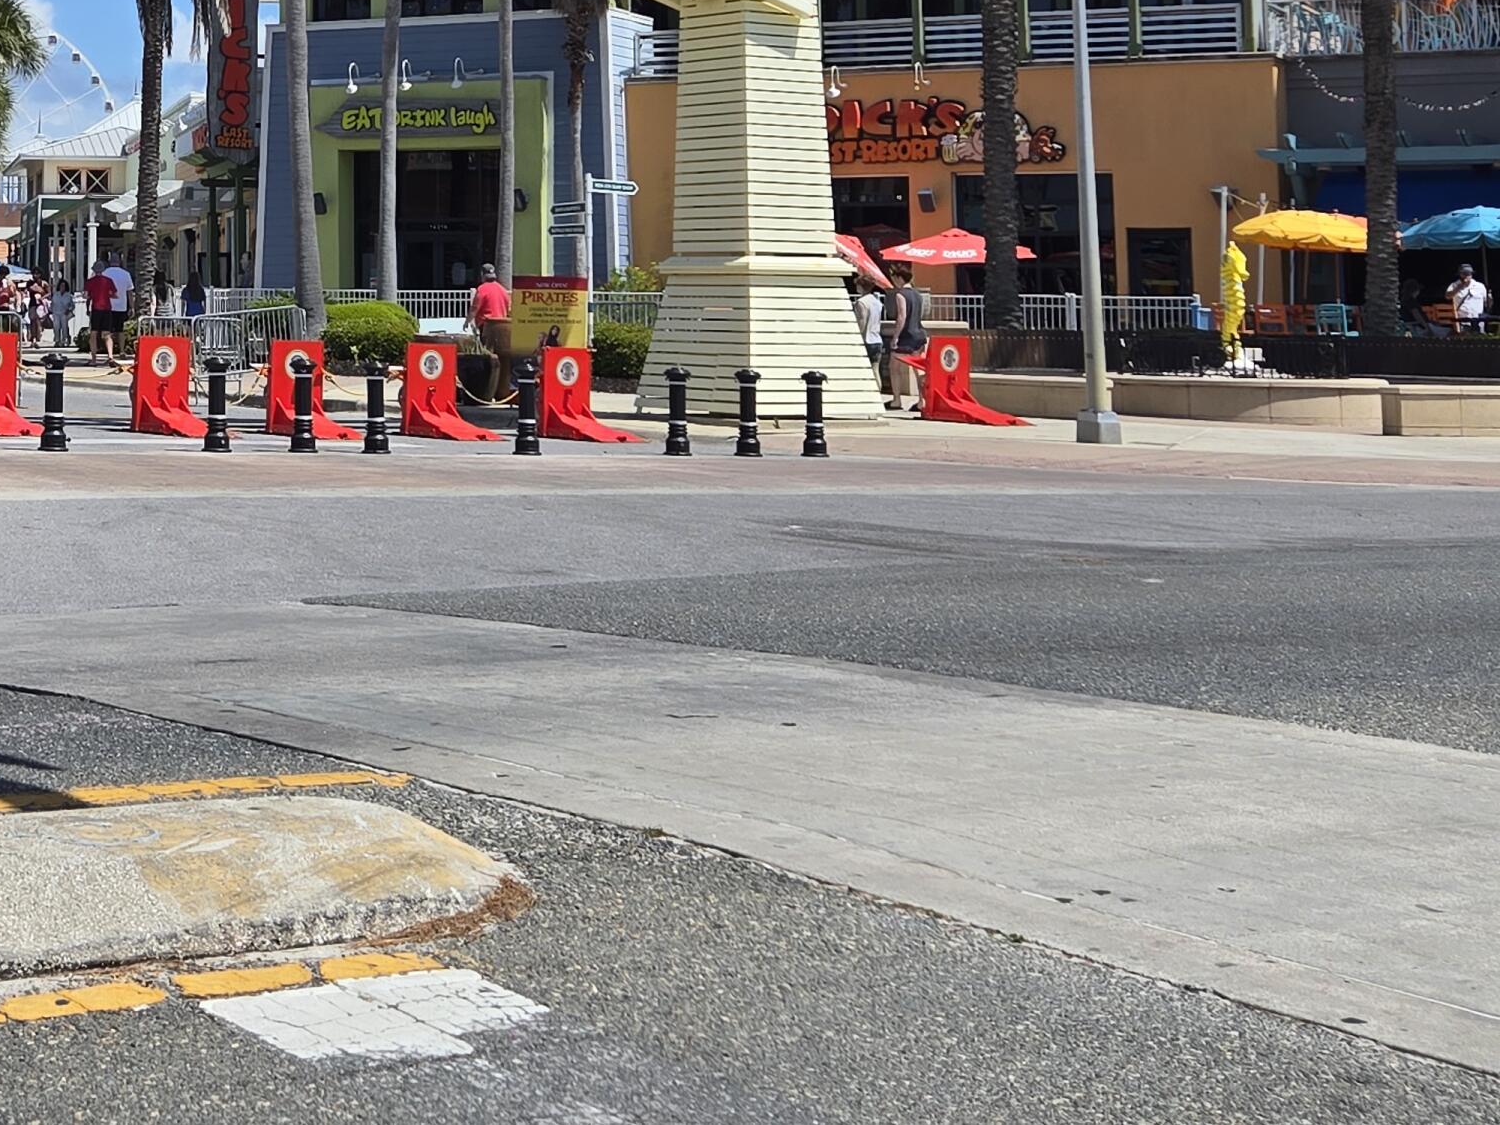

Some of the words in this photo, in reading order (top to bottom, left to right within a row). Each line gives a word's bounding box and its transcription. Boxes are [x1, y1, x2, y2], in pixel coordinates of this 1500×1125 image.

[342, 105, 383, 131] EAT
[450, 101, 496, 134] laugh
[222, 126, 249, 138] LAST
[216, 135, 255, 150] RESORT
[831, 140, 857, 164] ST
[859, 138, 939, 163] RESORT
[521, 291, 579, 306] PIRATES
